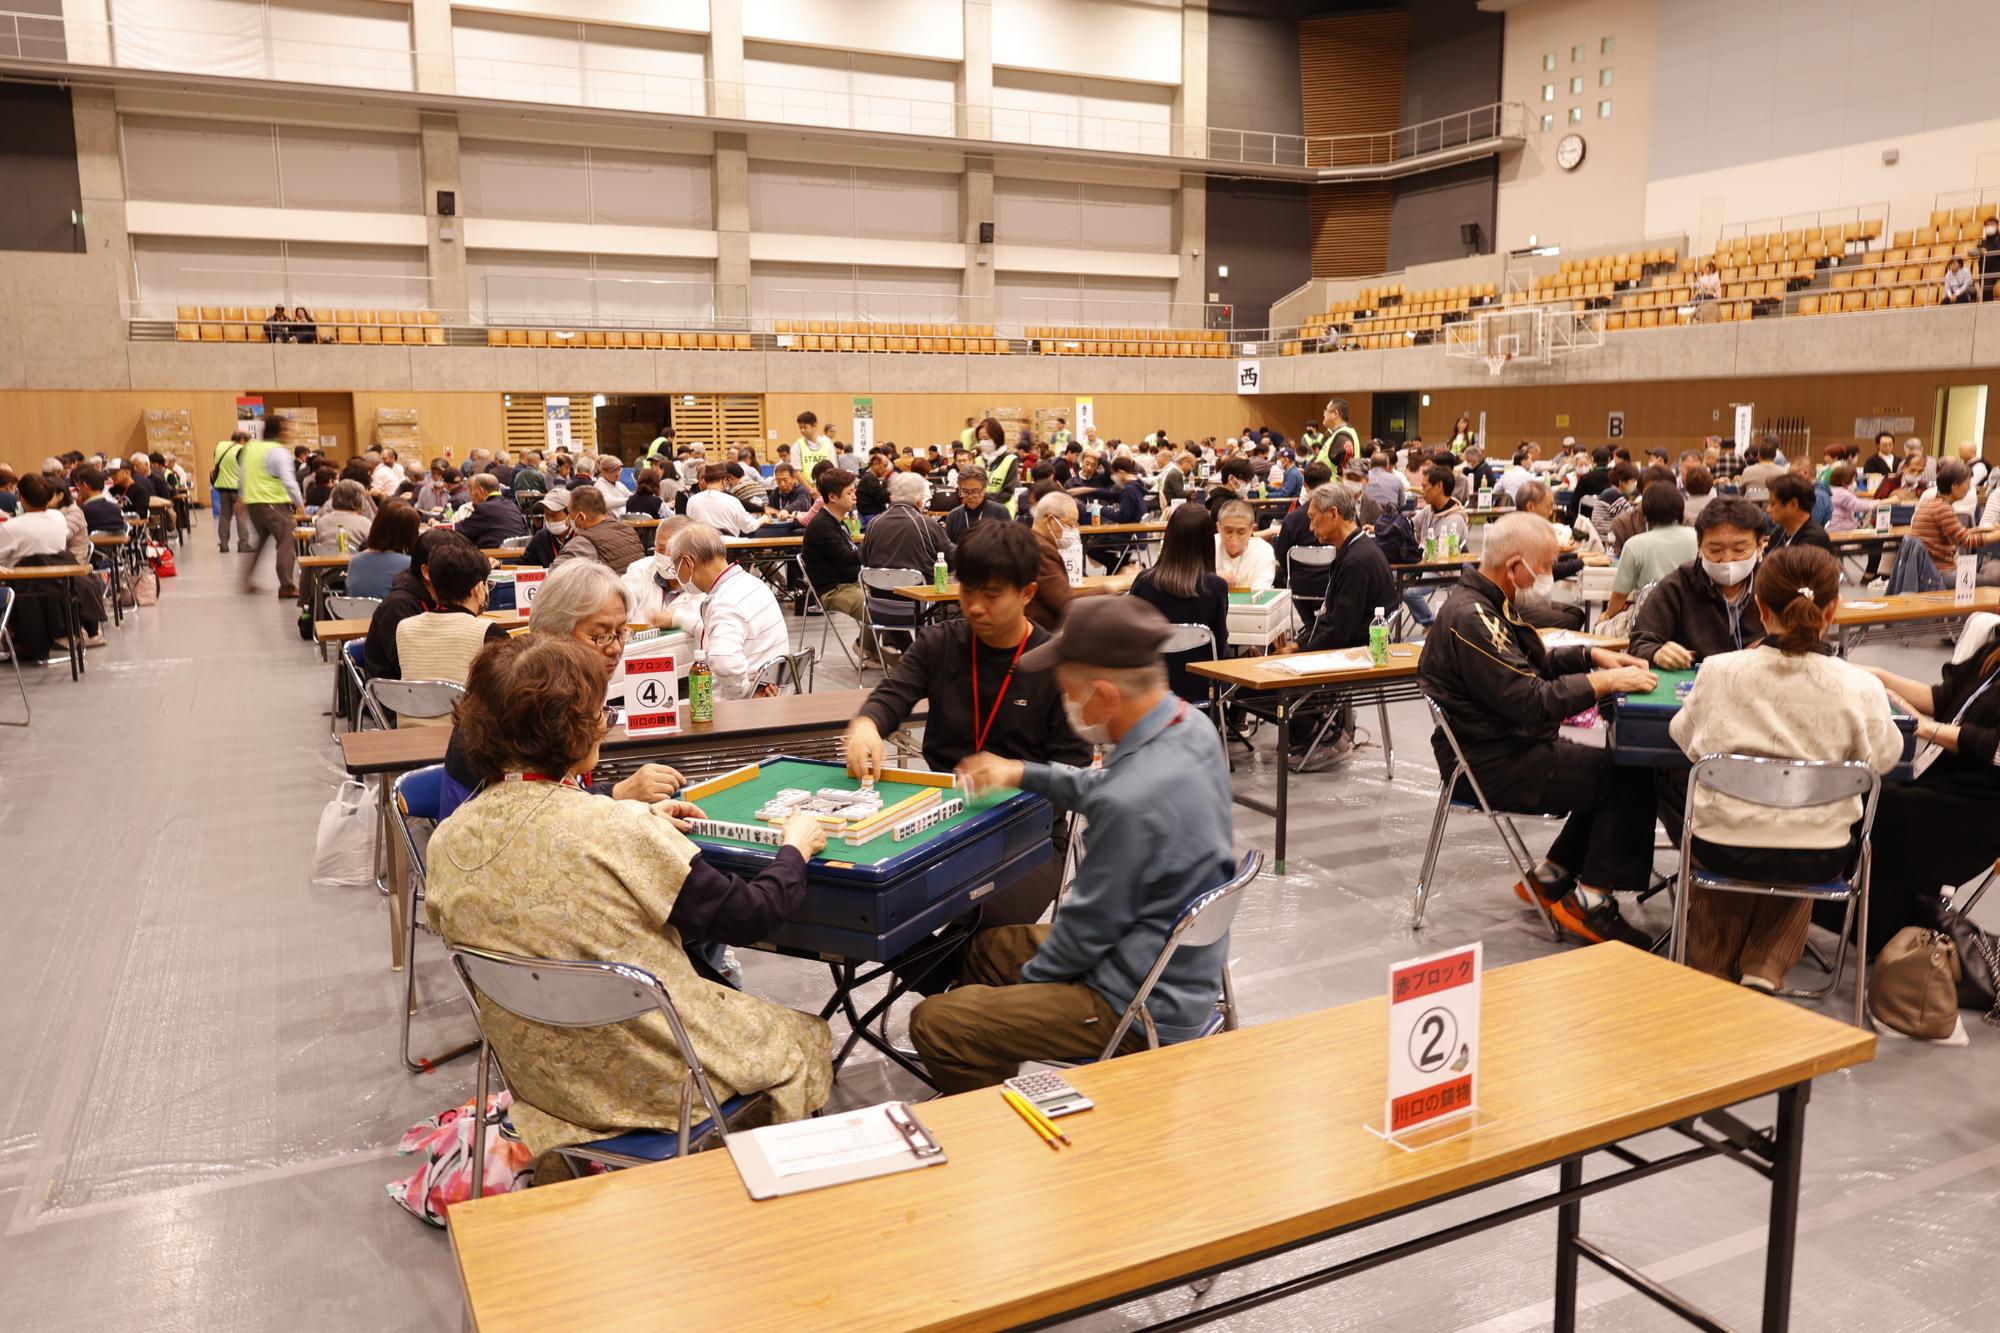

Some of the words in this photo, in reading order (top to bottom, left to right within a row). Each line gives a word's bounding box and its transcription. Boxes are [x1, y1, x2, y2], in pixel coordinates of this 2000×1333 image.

[1241, 367, 1258, 387] 西
[1610, 417, 1623, 437] B
[627, 661, 672, 672] 赤ブロック
[1396, 959, 1472, 995] 赤ブロック
